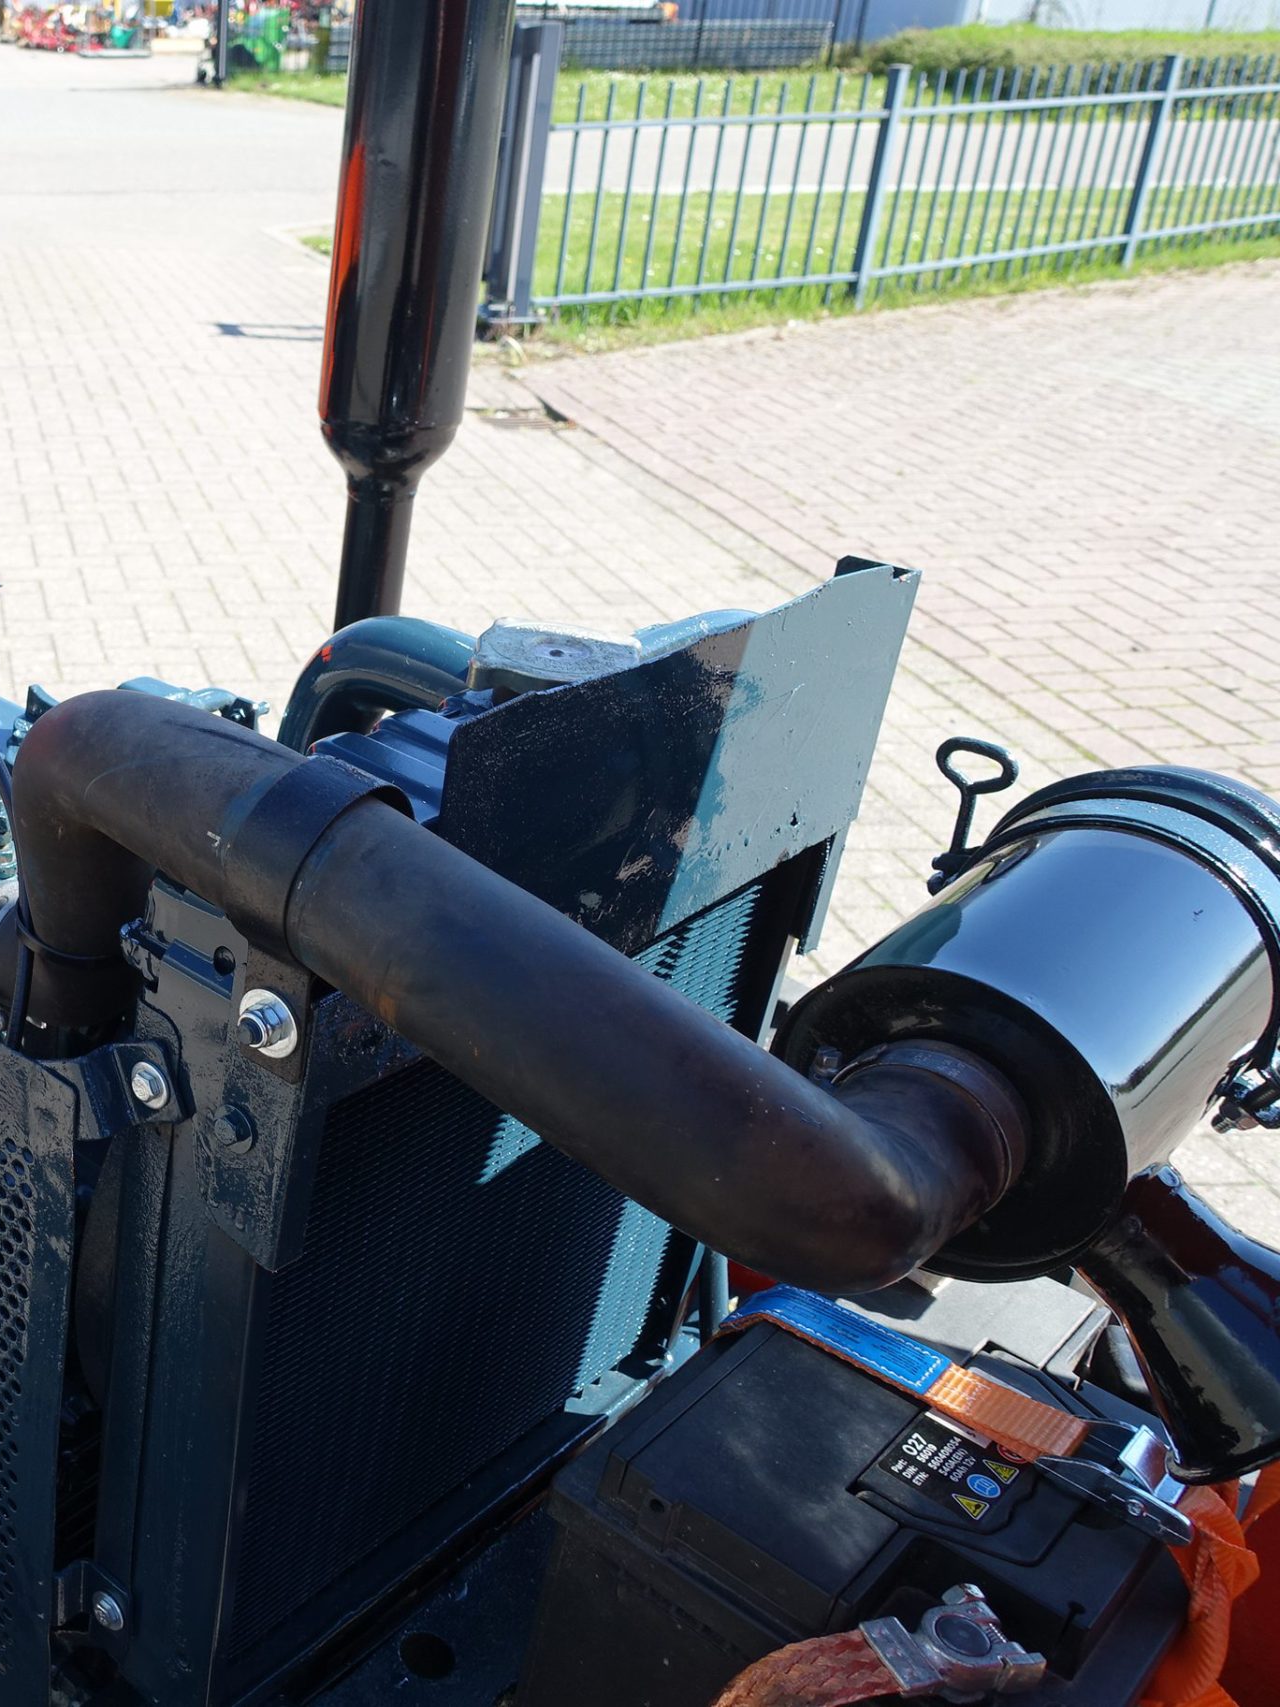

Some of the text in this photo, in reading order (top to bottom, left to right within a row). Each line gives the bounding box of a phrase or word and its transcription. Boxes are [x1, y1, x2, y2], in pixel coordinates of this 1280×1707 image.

[890, 1432, 927, 1473] Part: 027
[902, 1443, 937, 1479] DIN: 56019
[912, 1472, 930, 1486] ETN:
[949, 1465, 969, 1482] 60Ah
